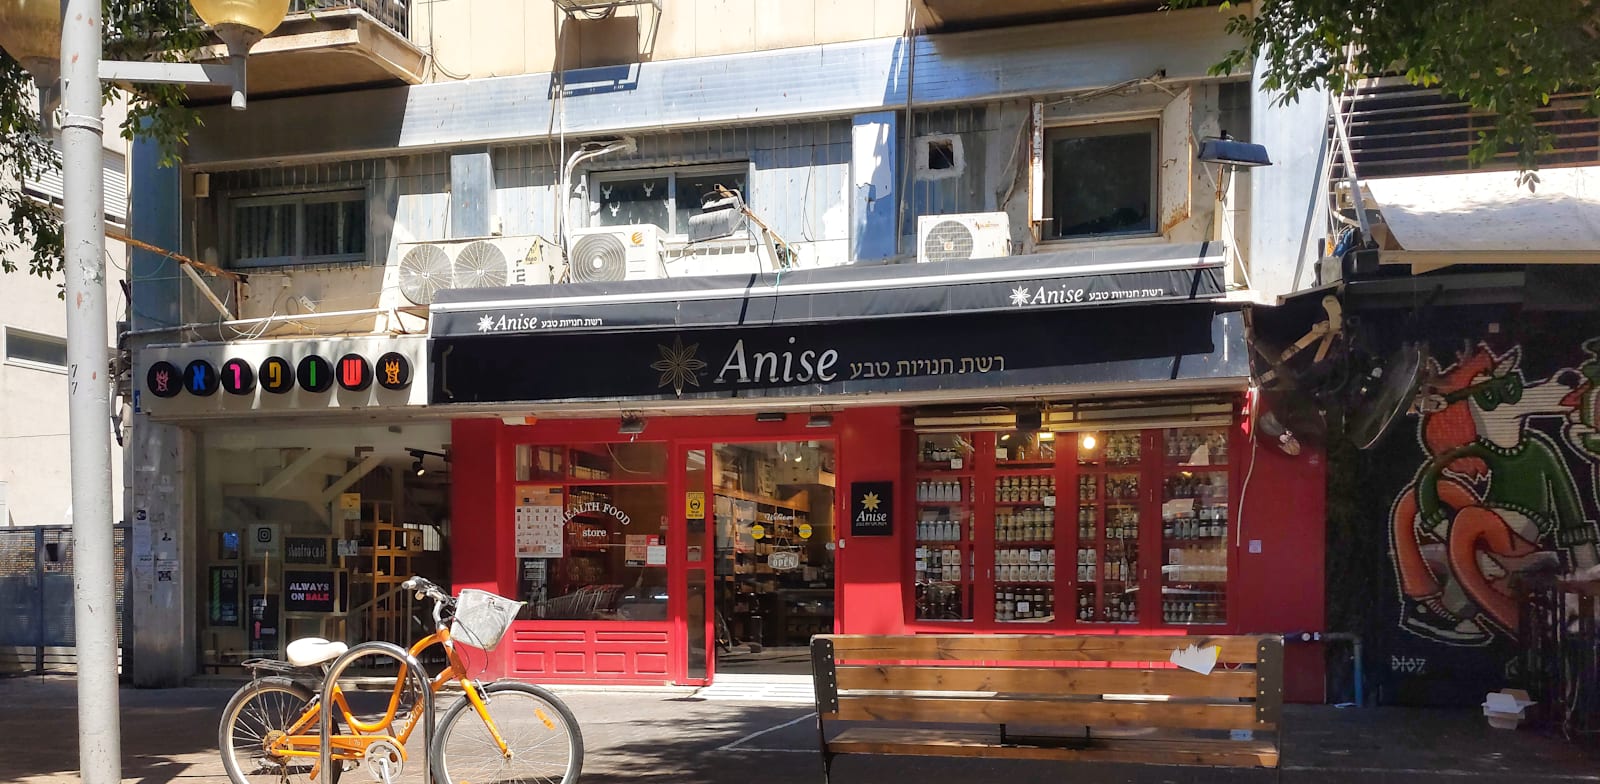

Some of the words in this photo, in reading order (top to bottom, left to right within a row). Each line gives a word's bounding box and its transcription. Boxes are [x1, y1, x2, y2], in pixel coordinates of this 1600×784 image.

[1030, 284, 1084, 305] Anise
[1088, 291, 1109, 302] טבע
[1111, 289, 1140, 299] חנויות
[1141, 288, 1164, 298] רשת
[494, 313, 538, 331] Anise
[541, 319, 559, 329] טבע
[713, 336, 838, 384] Anise
[959, 356, 1005, 374] רשת
[850, 361, 890, 380] טבע
[896, 358, 954, 376] חנויות
[602, 502, 631, 526] FOOD
[855, 509, 887, 522] Anise
[582, 528, 607, 537] store
[289, 582, 329, 591] ALWAYS
[291, 592, 305, 601] ON
[305, 593, 329, 601] SALE
